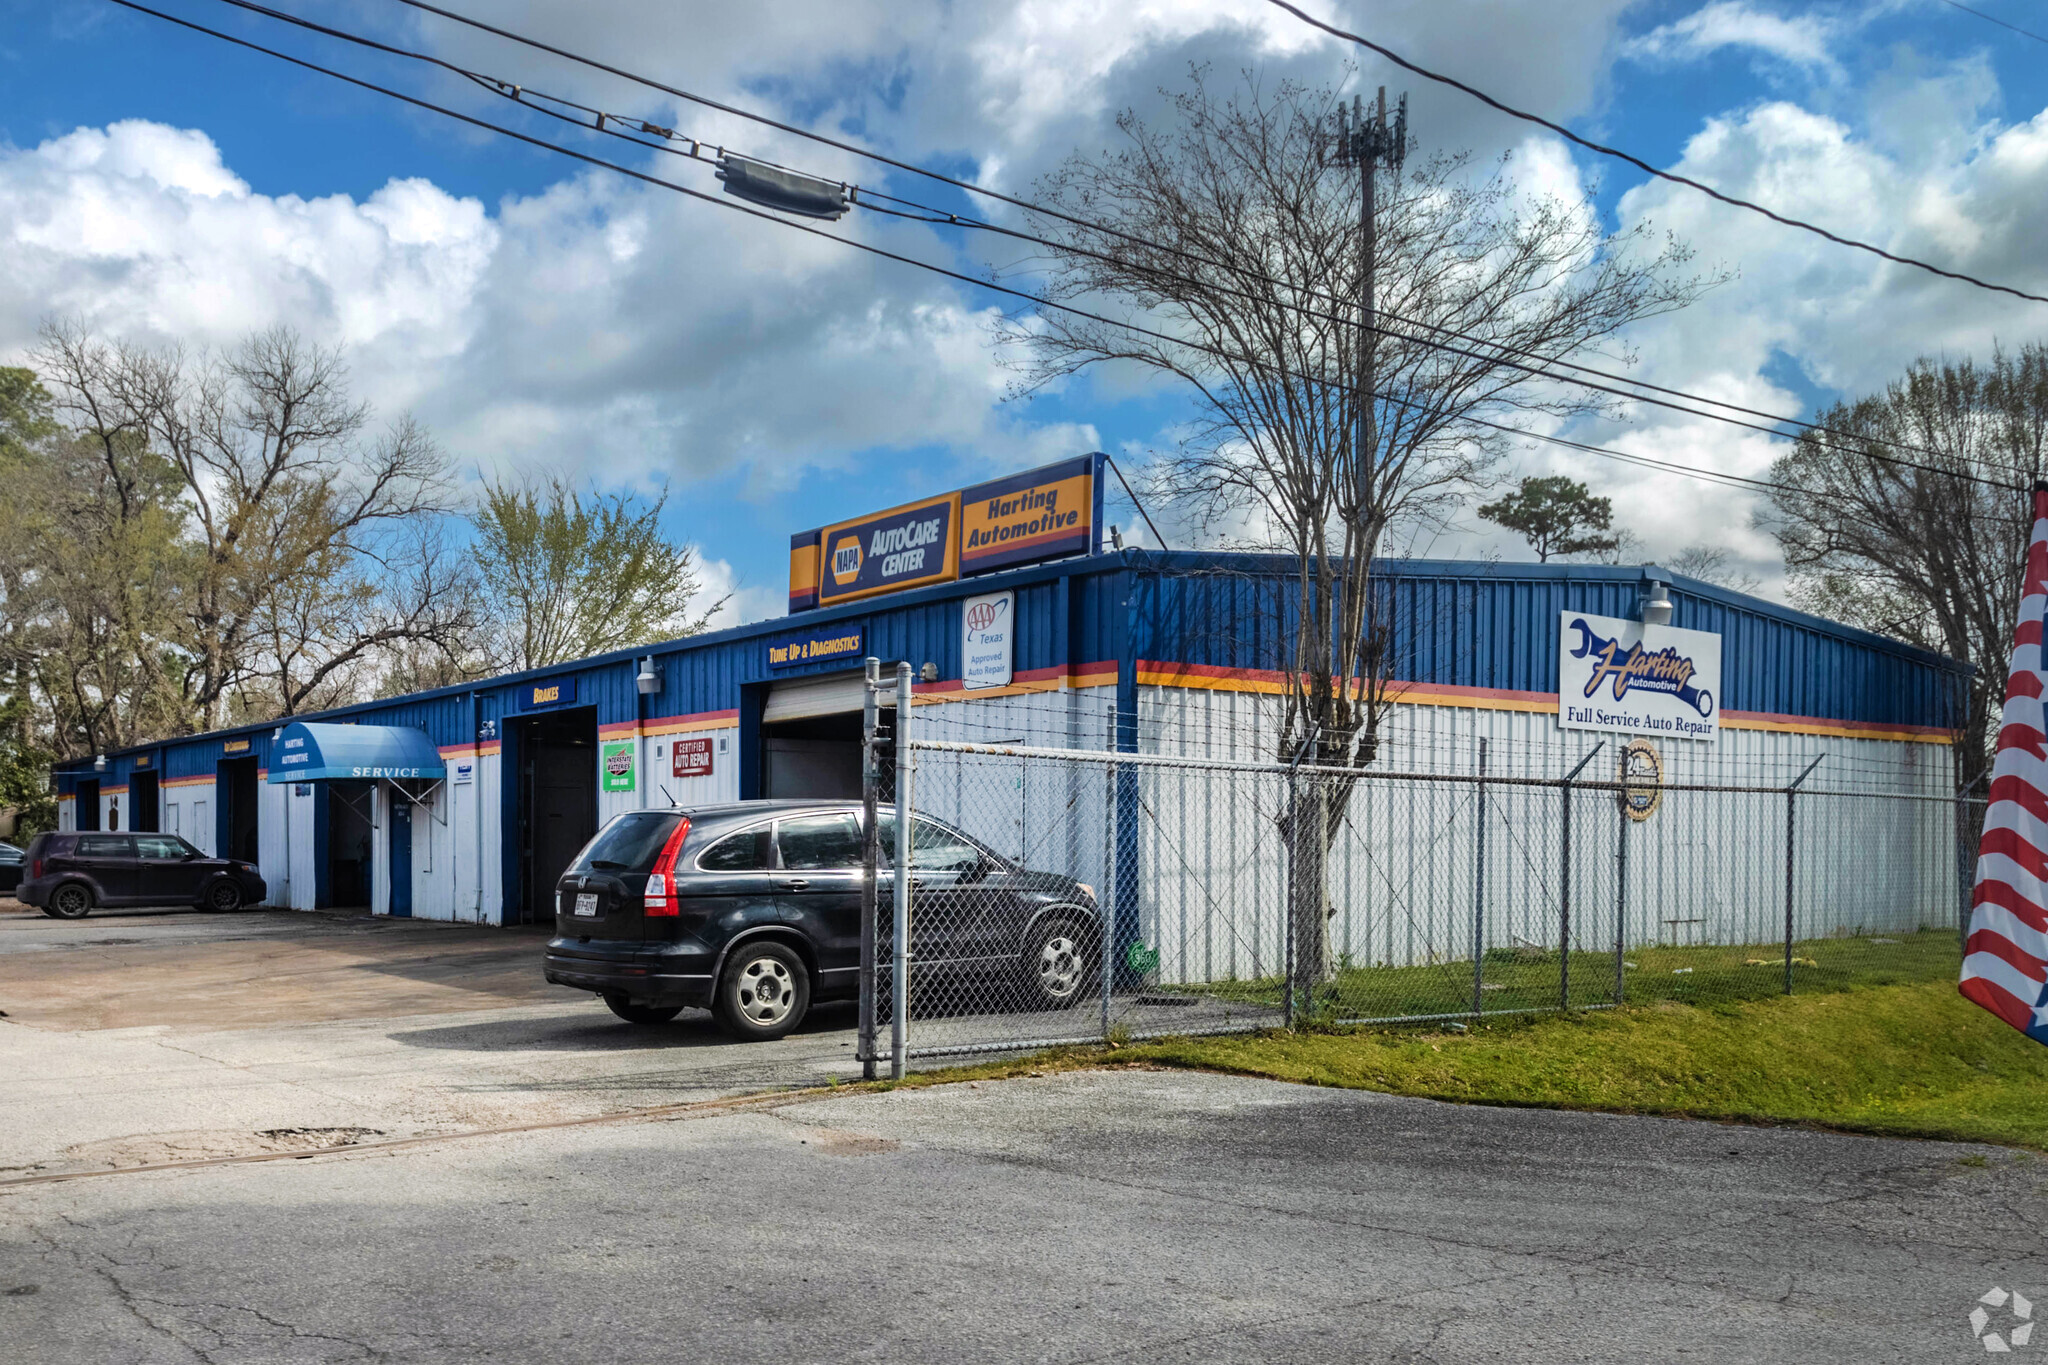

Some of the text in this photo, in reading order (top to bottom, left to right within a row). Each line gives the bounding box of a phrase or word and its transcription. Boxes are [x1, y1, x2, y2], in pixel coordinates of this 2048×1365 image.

[987, 489, 1058, 520] Harting
[967, 509, 1078, 549] Automotive
[836, 547, 859, 573] NAPA
[881, 548, 925, 577] CENTER
[969, 603, 995, 630] AAA
[980, 633, 1004, 645] Texas
[769, 635, 860, 664] TUNE UP & DIAGNOSTICS
[971, 651, 1003, 665] Approved
[968, 664, 1006, 676] Auto Repair
[1584, 640, 1694, 699] Harting
[1628, 677, 1678, 691] Automotive
[533, 686, 560, 704] BRAKES
[1567, 706, 1713, 737] Full Service Auto Repair
[284, 738, 304, 749] HARTING
[679, 741, 706, 754] CERTIFIED
[281, 752, 309, 765] AUTOMOTIVE
[607, 755, 632, 763] INTERSTATE
[675, 752, 710, 768] AUTO REPAIR
[1627, 756, 1641, 776] 24
[352, 766, 420, 778] SERVICE
[608, 763, 631, 771] BATTERIES
